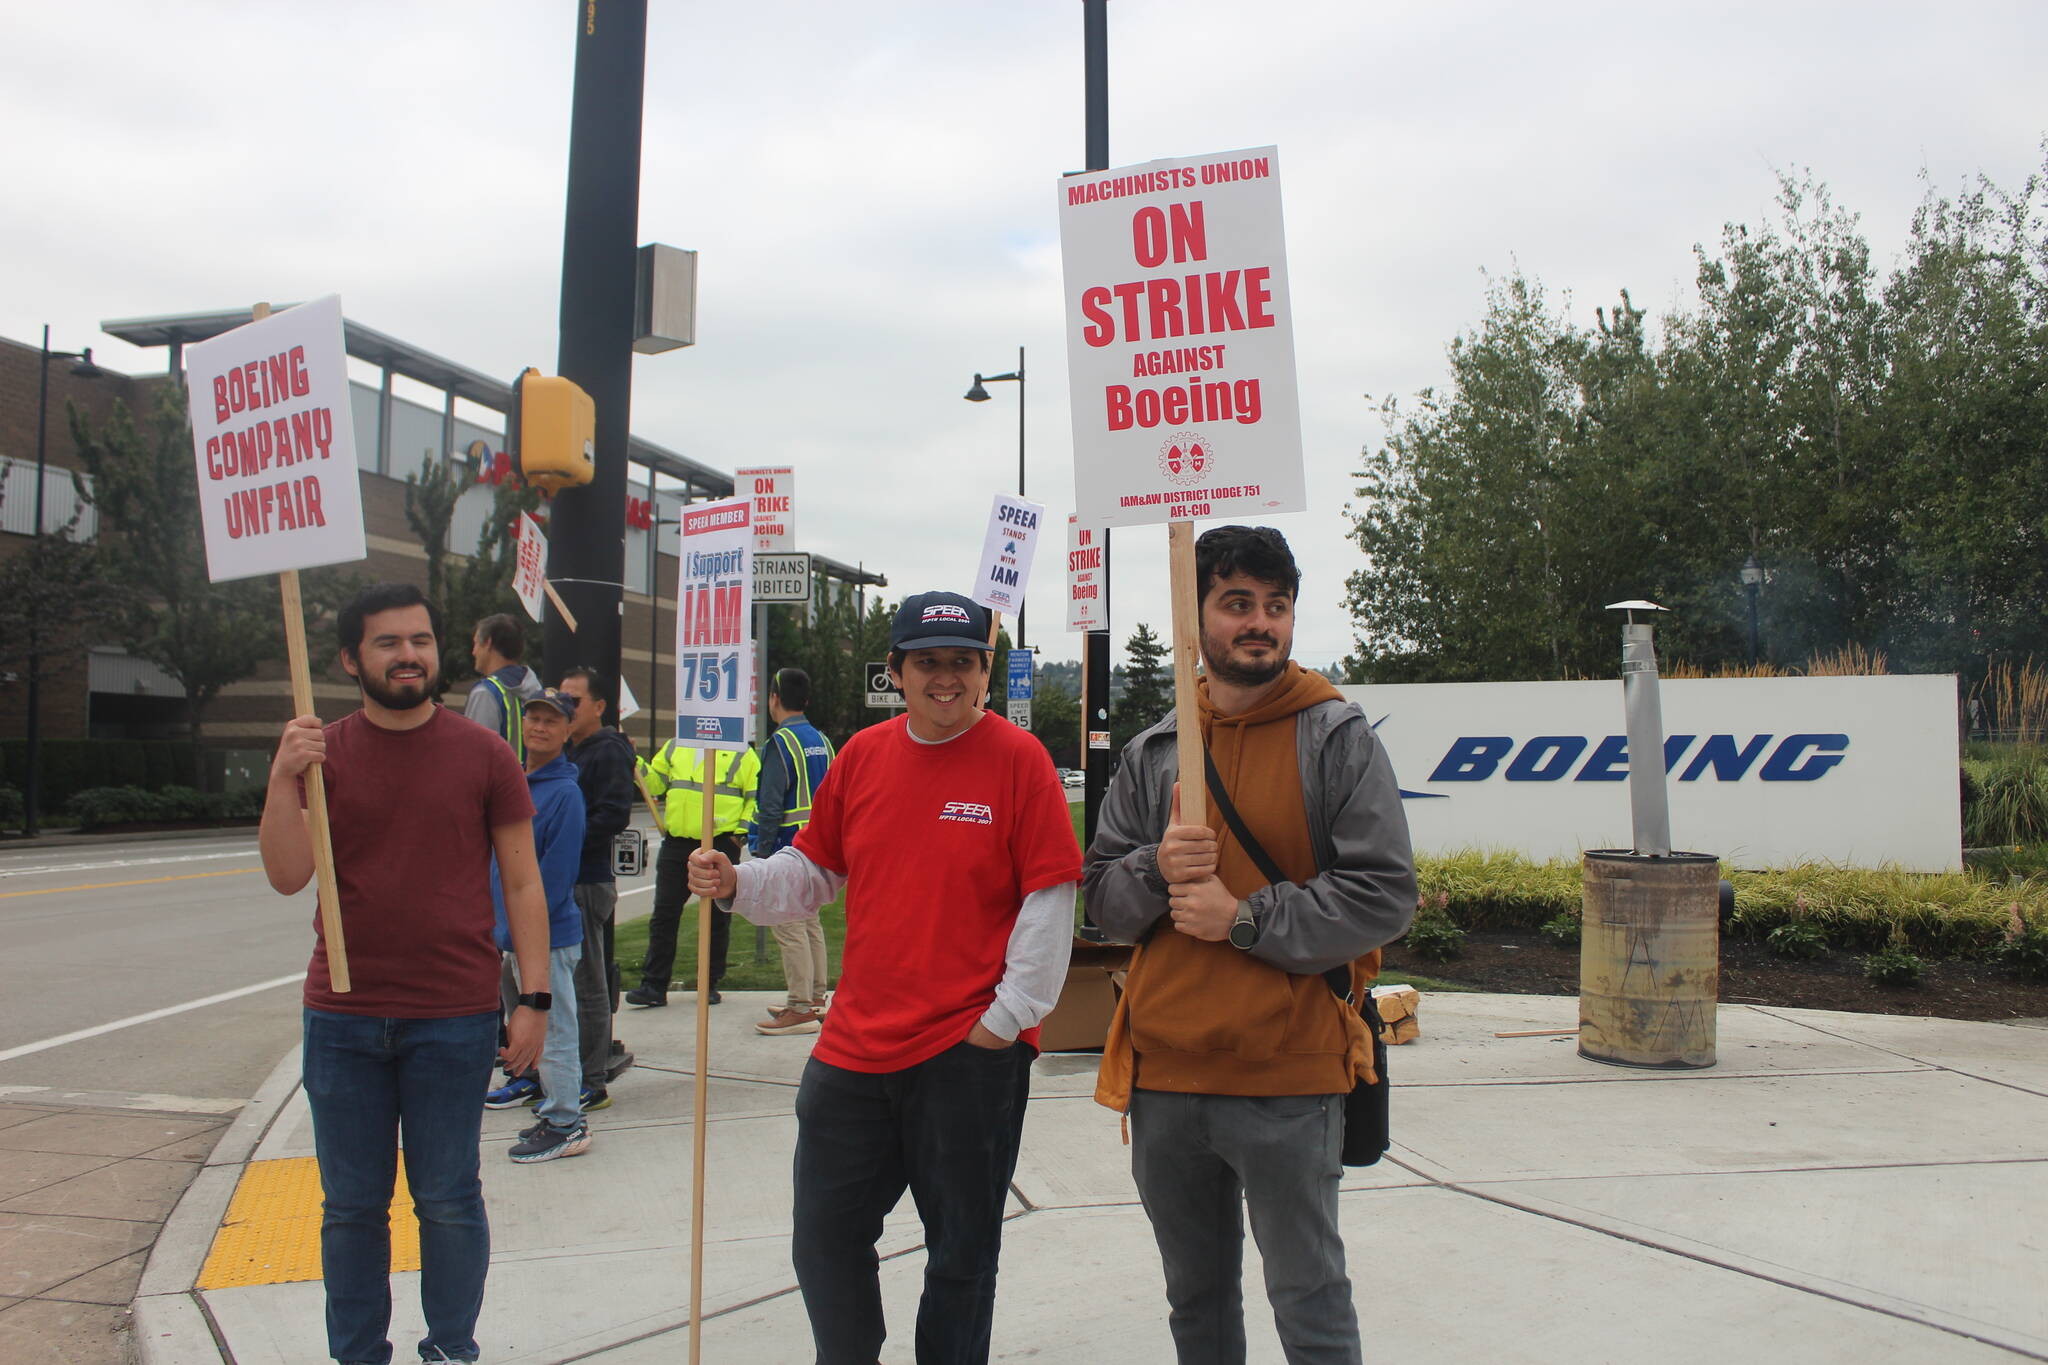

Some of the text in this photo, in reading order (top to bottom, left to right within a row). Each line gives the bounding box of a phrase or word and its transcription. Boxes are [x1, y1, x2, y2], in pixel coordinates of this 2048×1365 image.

[1068, 157, 1269, 206] MACHINISTS UNION
[1132, 200, 1207, 268] ON
[1081, 266, 1275, 348] STRIKE
[1133, 344, 1225, 378] AGAINST
[213, 344, 310, 425] BOEING
[1105, 376, 1262, 431] Boeing
[206, 407, 332, 481] COMPANY
[755, 478, 774, 494] ON
[1120, 485, 1260, 508] IAM&AW DISTRICT LODGE 751
[224, 475, 326, 539] UNFAIR
[754, 496, 789, 512] RIKE
[1170, 503, 1211, 518] AFL-CIO
[688, 509, 744, 530] SPEEA MEMBER
[998, 505, 1037, 530] SPEEA
[1002, 528, 1026, 541] STANDS
[686, 547, 743, 582] I Support
[752, 561, 804, 574] STRIANS
[1000, 555, 1016, 565] WITH
[1069, 547, 1101, 572] STRIKE
[753, 580, 801, 594] HIBITED
[990, 565, 1019, 587] IAM
[1077, 573, 1092, 583] AGAINST
[1072, 583, 1098, 600] Boeing
[683, 580, 743, 647] IAM
[922, 604, 970, 619] SPEEA
[683, 652, 739, 702] 751
[871, 695, 889, 704] BIKE
[1010, 716, 1028, 727] 35
[942, 802, 992, 820] SPEEA
